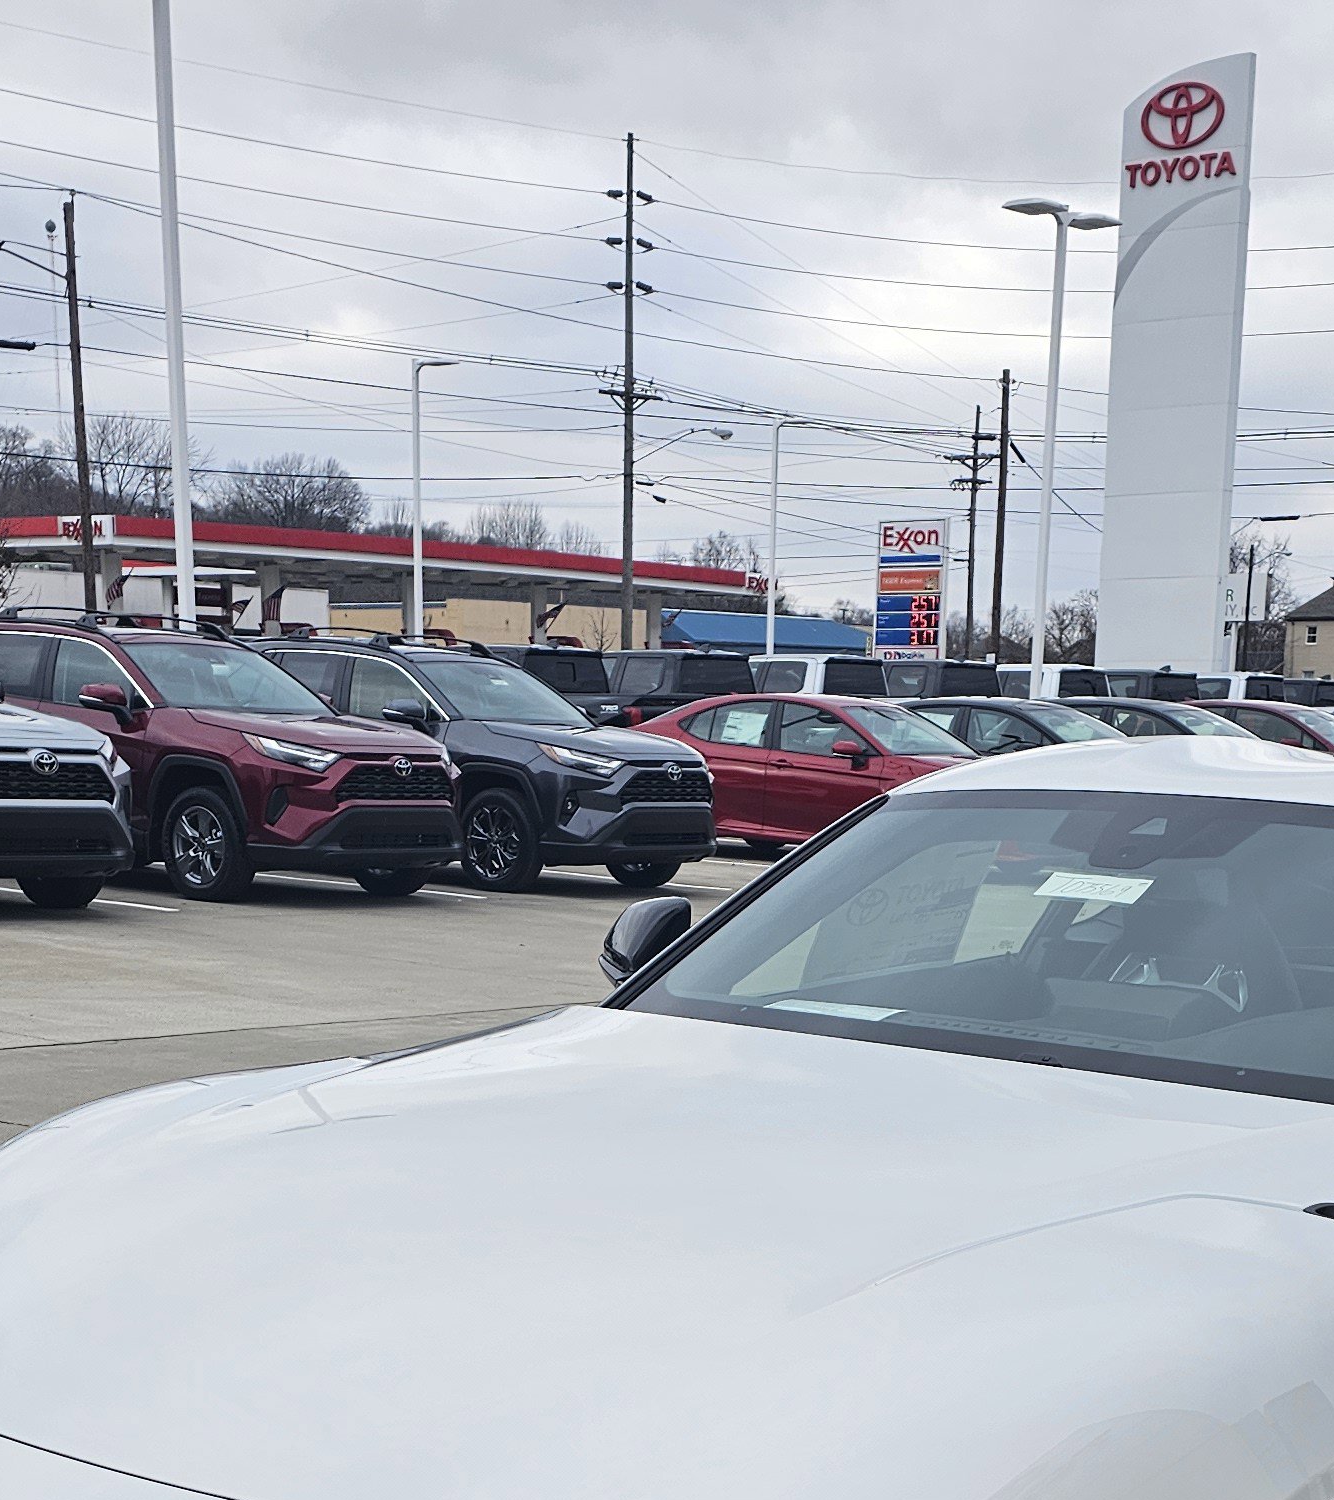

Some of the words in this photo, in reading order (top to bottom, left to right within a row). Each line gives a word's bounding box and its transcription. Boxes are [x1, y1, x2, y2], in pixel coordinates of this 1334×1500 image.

[1125, 151, 1237, 189] TOYOTA
[62, 518, 103, 542] EXXN
[883, 526, 939, 553] Exxon
